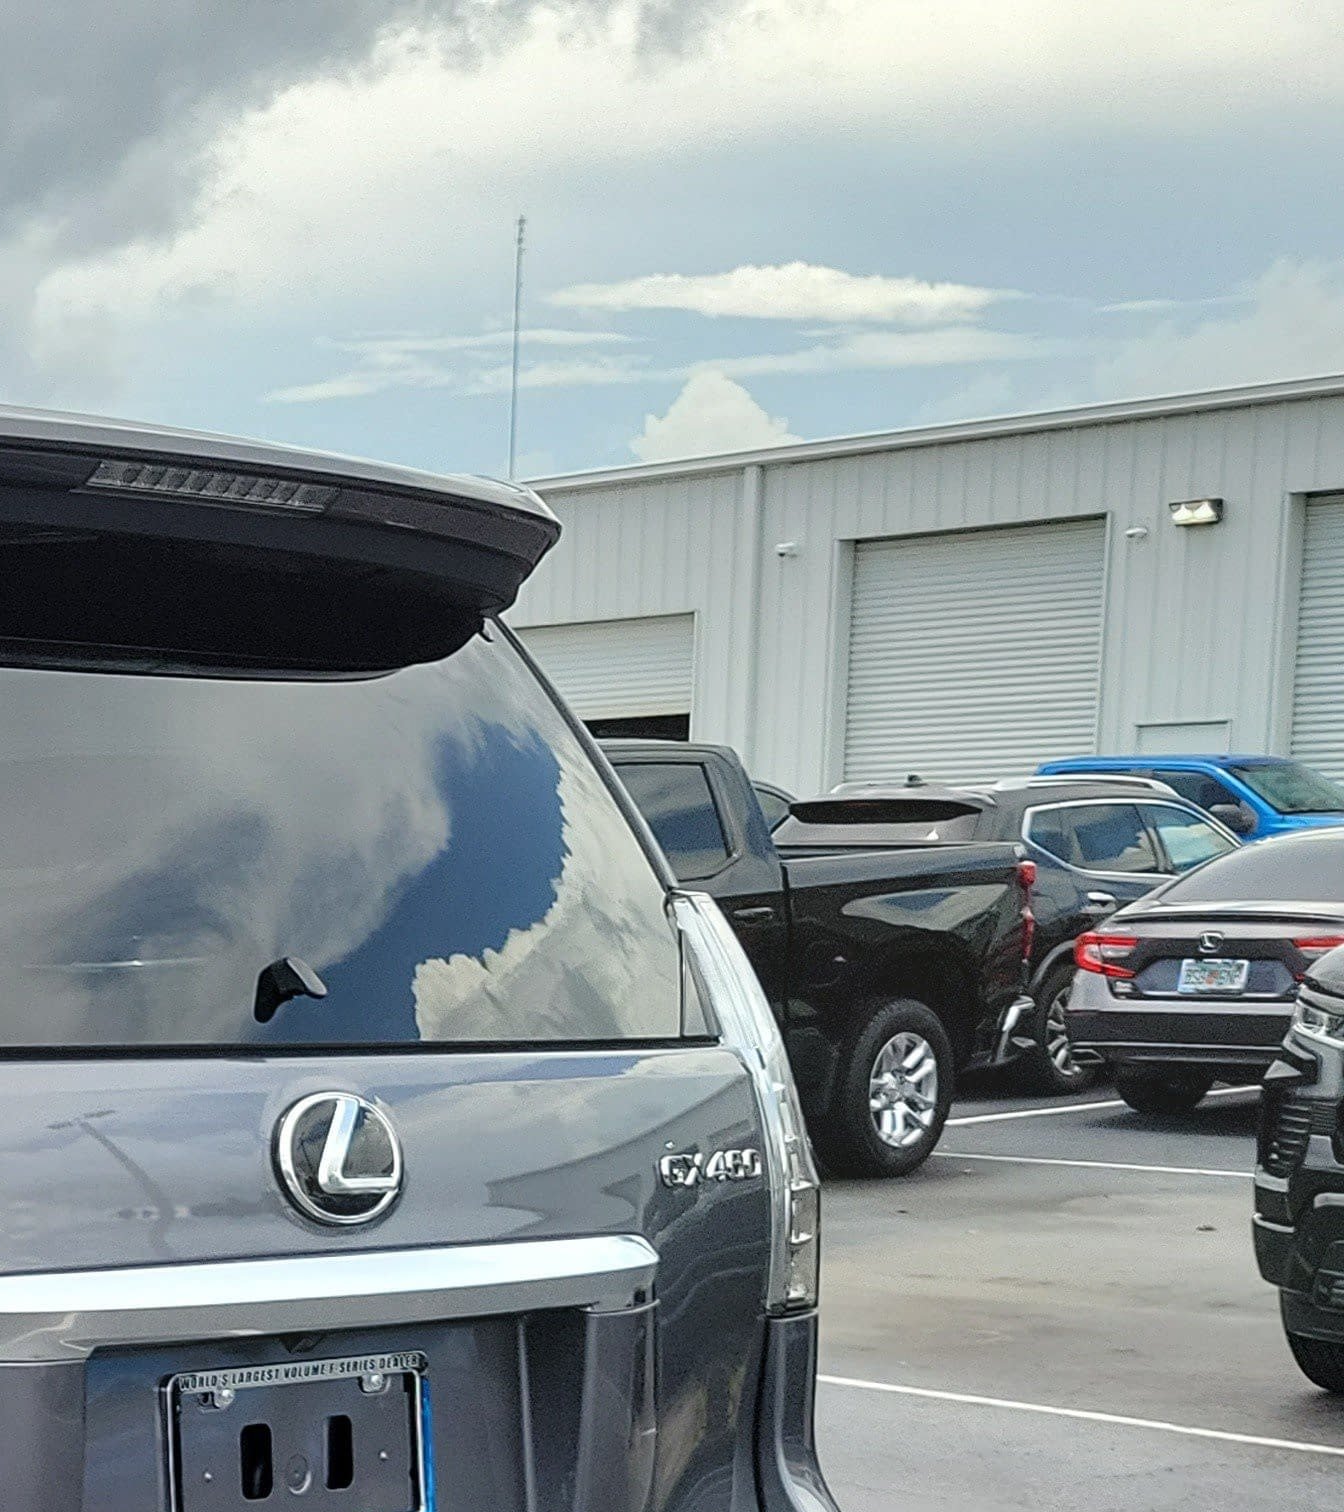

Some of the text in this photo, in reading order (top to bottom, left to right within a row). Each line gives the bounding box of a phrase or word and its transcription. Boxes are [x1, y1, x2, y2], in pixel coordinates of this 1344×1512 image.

[660, 1152, 704, 1186] GX
[231, 1367, 279, 1385] LARGEST
[283, 1362, 325, 1379] VOLUME
[378, 1353, 417, 1370] DEALER
